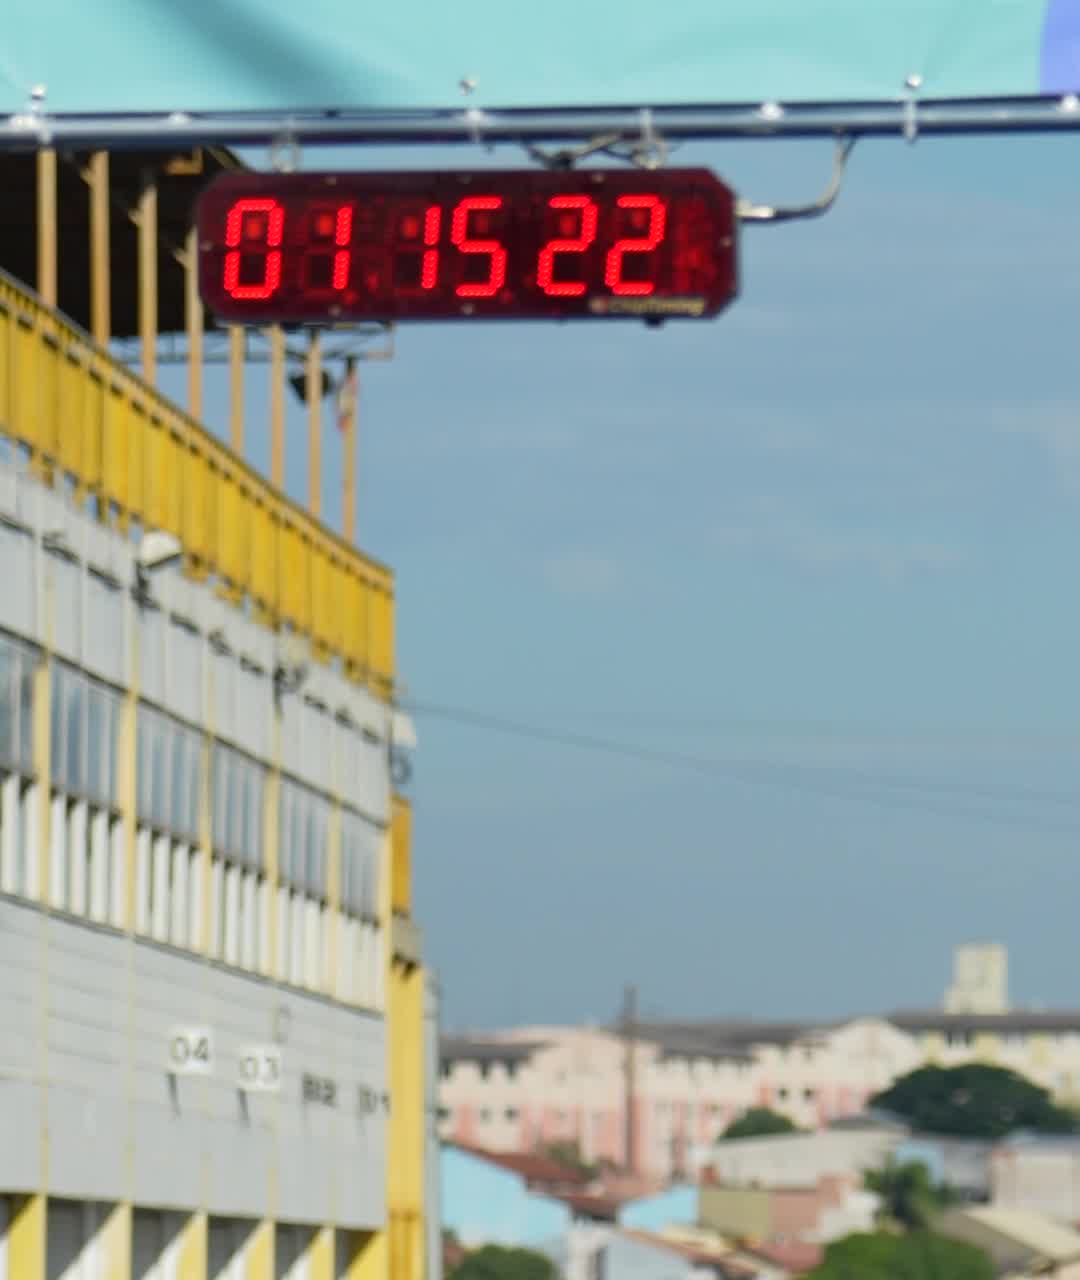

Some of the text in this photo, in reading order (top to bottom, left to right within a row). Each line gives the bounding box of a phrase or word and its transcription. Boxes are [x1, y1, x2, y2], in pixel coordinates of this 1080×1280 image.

[224, 195, 666, 299] 01 15 22
